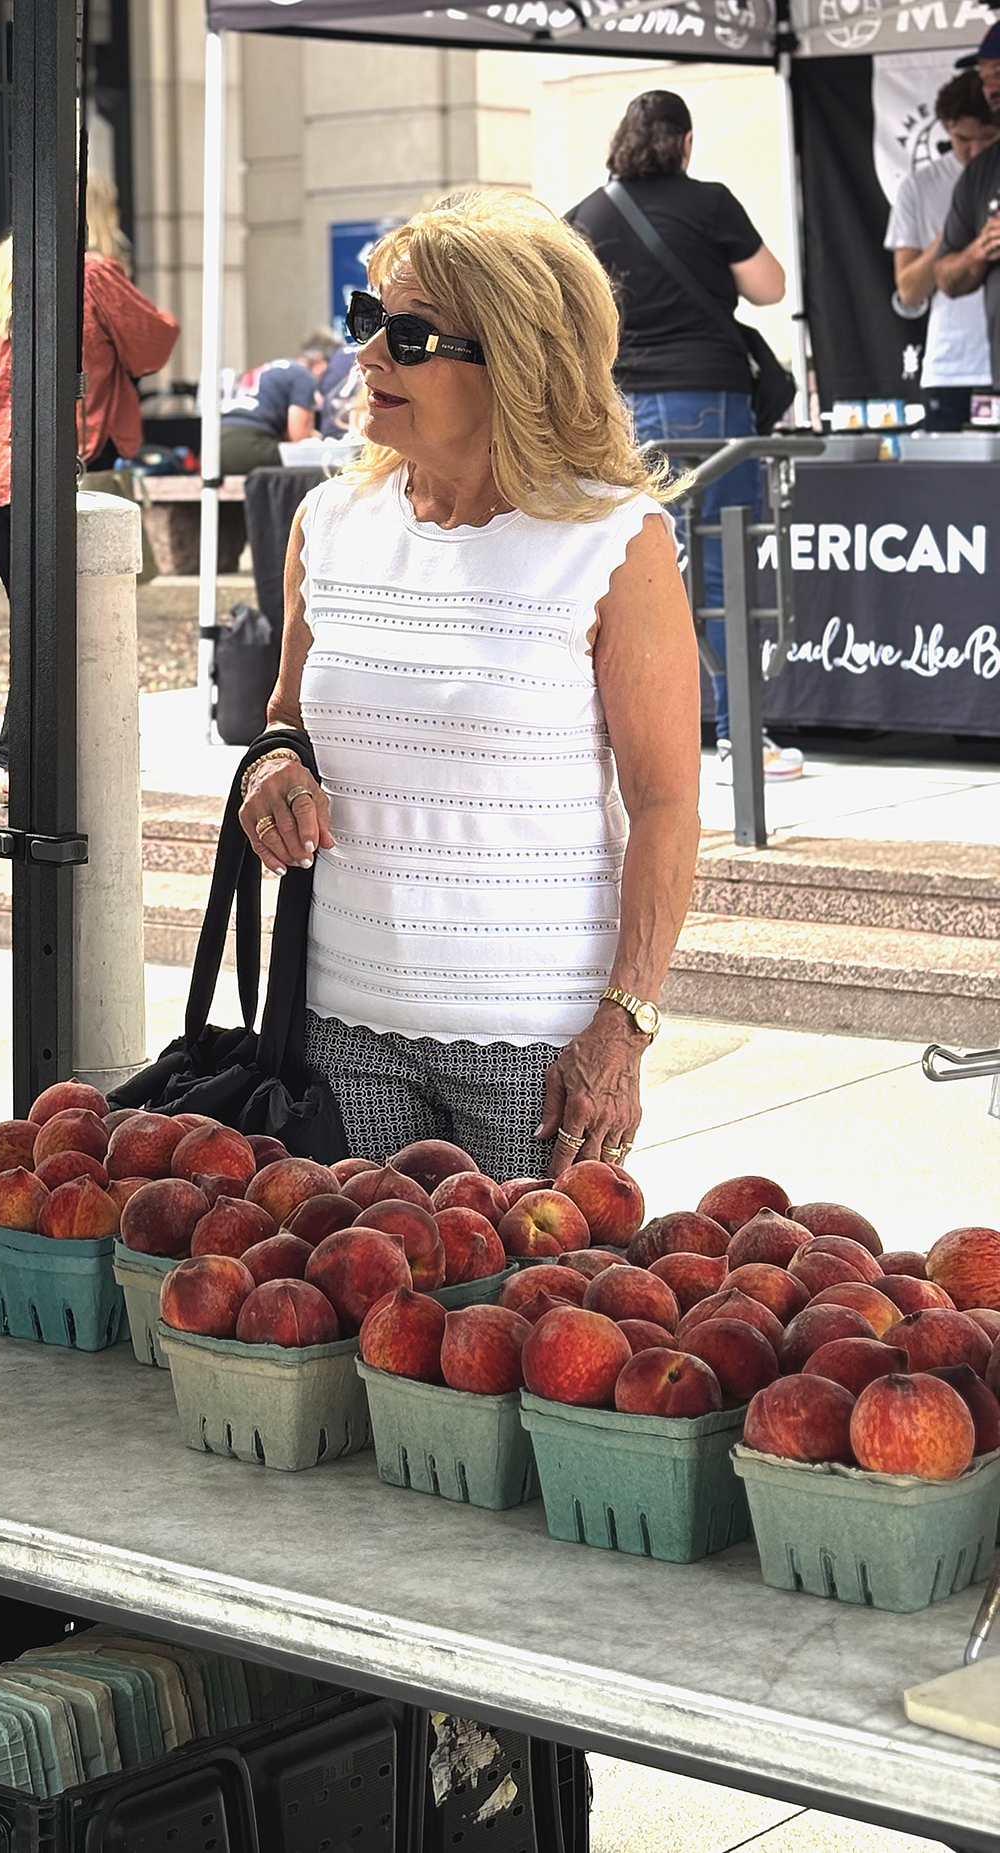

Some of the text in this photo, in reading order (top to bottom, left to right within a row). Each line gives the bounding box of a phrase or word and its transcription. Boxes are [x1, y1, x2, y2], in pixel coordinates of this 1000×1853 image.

[896, 103, 929, 148] AME
[833, 623, 902, 674] Love
[900, 623, 965, 677] Like
